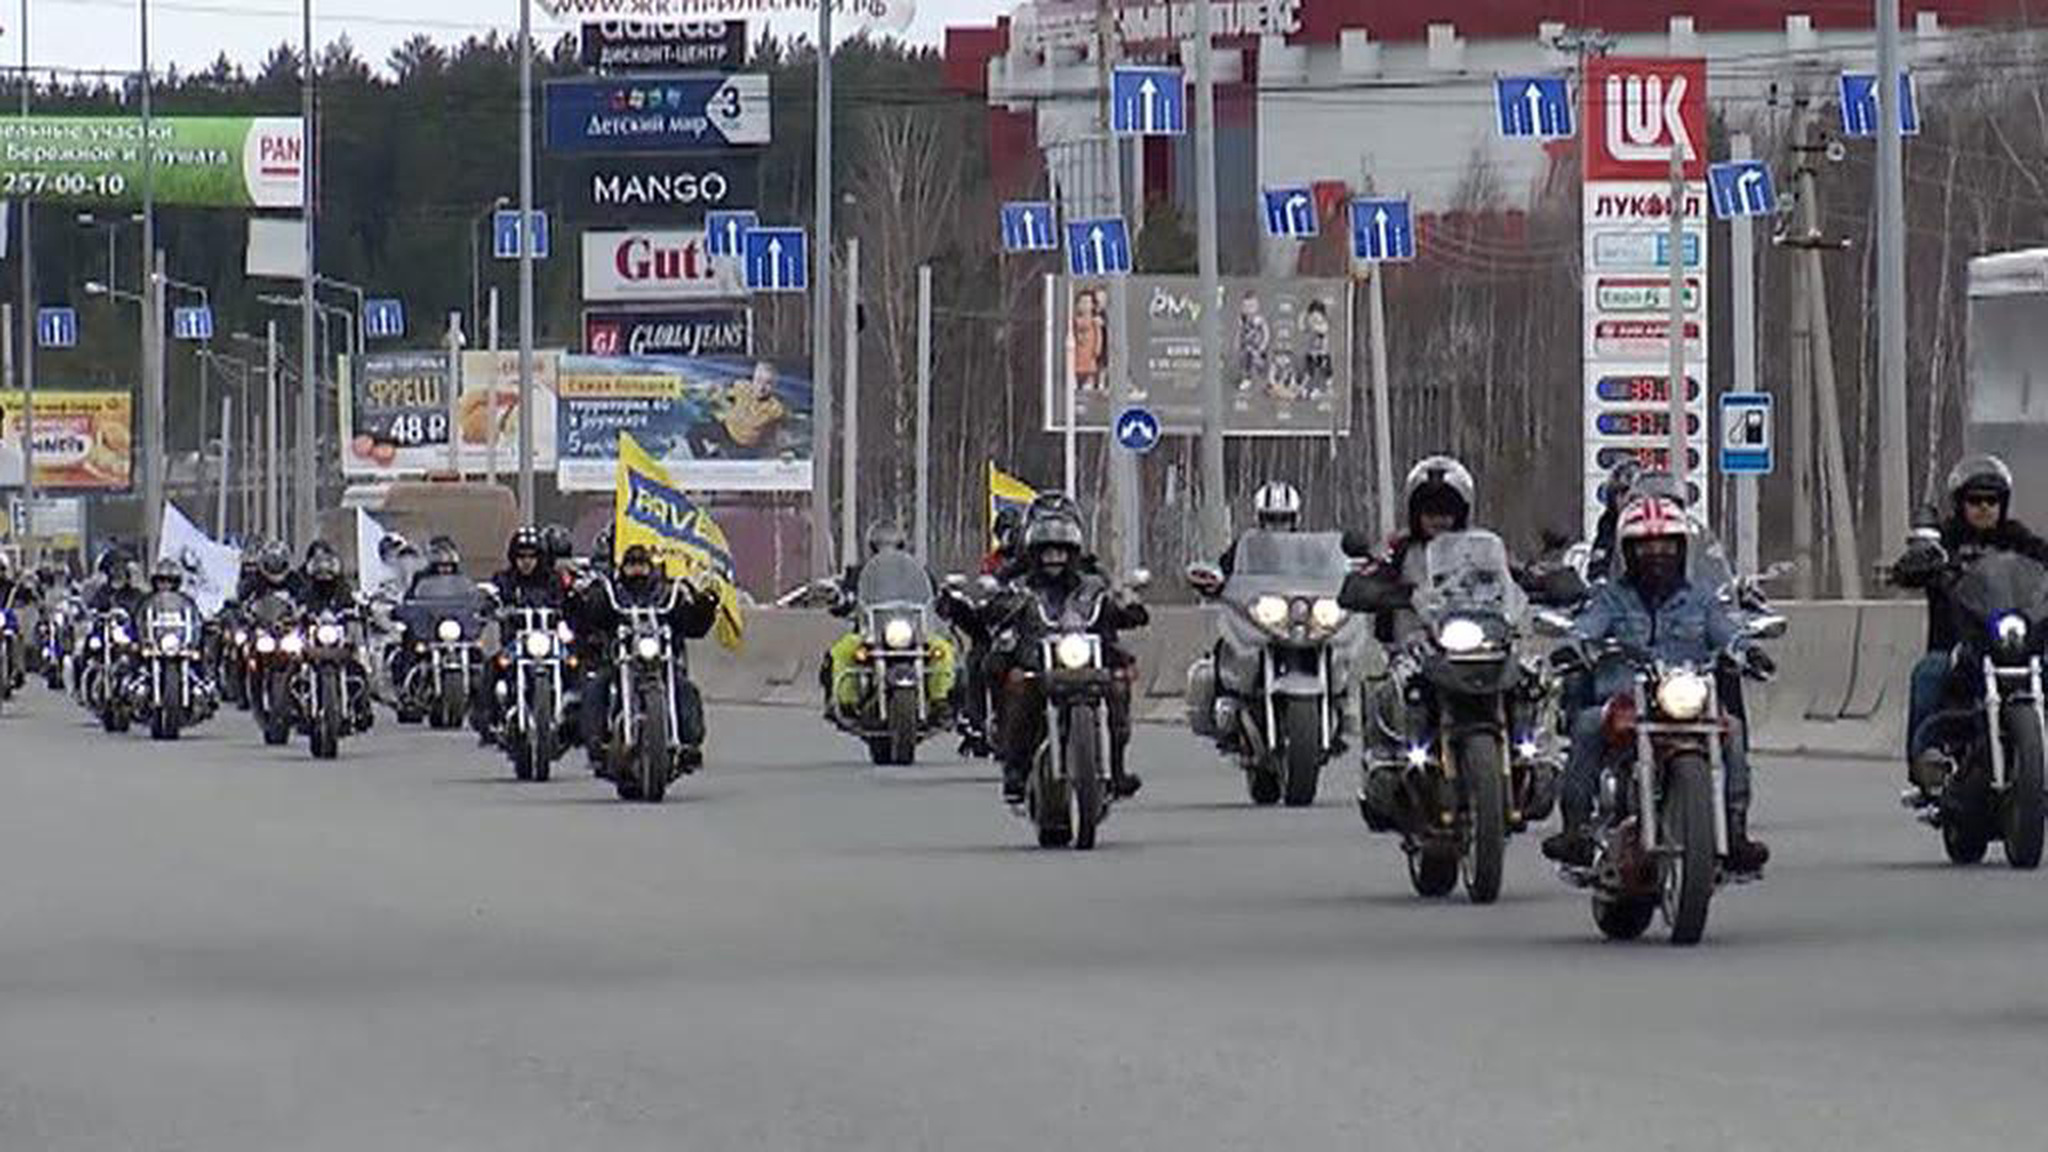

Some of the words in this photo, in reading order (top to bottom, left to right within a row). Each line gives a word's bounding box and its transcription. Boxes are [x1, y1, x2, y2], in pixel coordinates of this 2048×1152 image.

[720, 86, 742, 119] 3
[0, 123, 80, 141] ельные
[586, 114, 664, 136] Детский
[667, 117, 709, 138] мир
[7, 144, 117, 164] Бережное
[147, 143, 229, 167] лушата
[3, 171, 125, 195] 257-00-10
[594, 172, 727, 203] MANGO
[390, 413, 423, 444] 48
